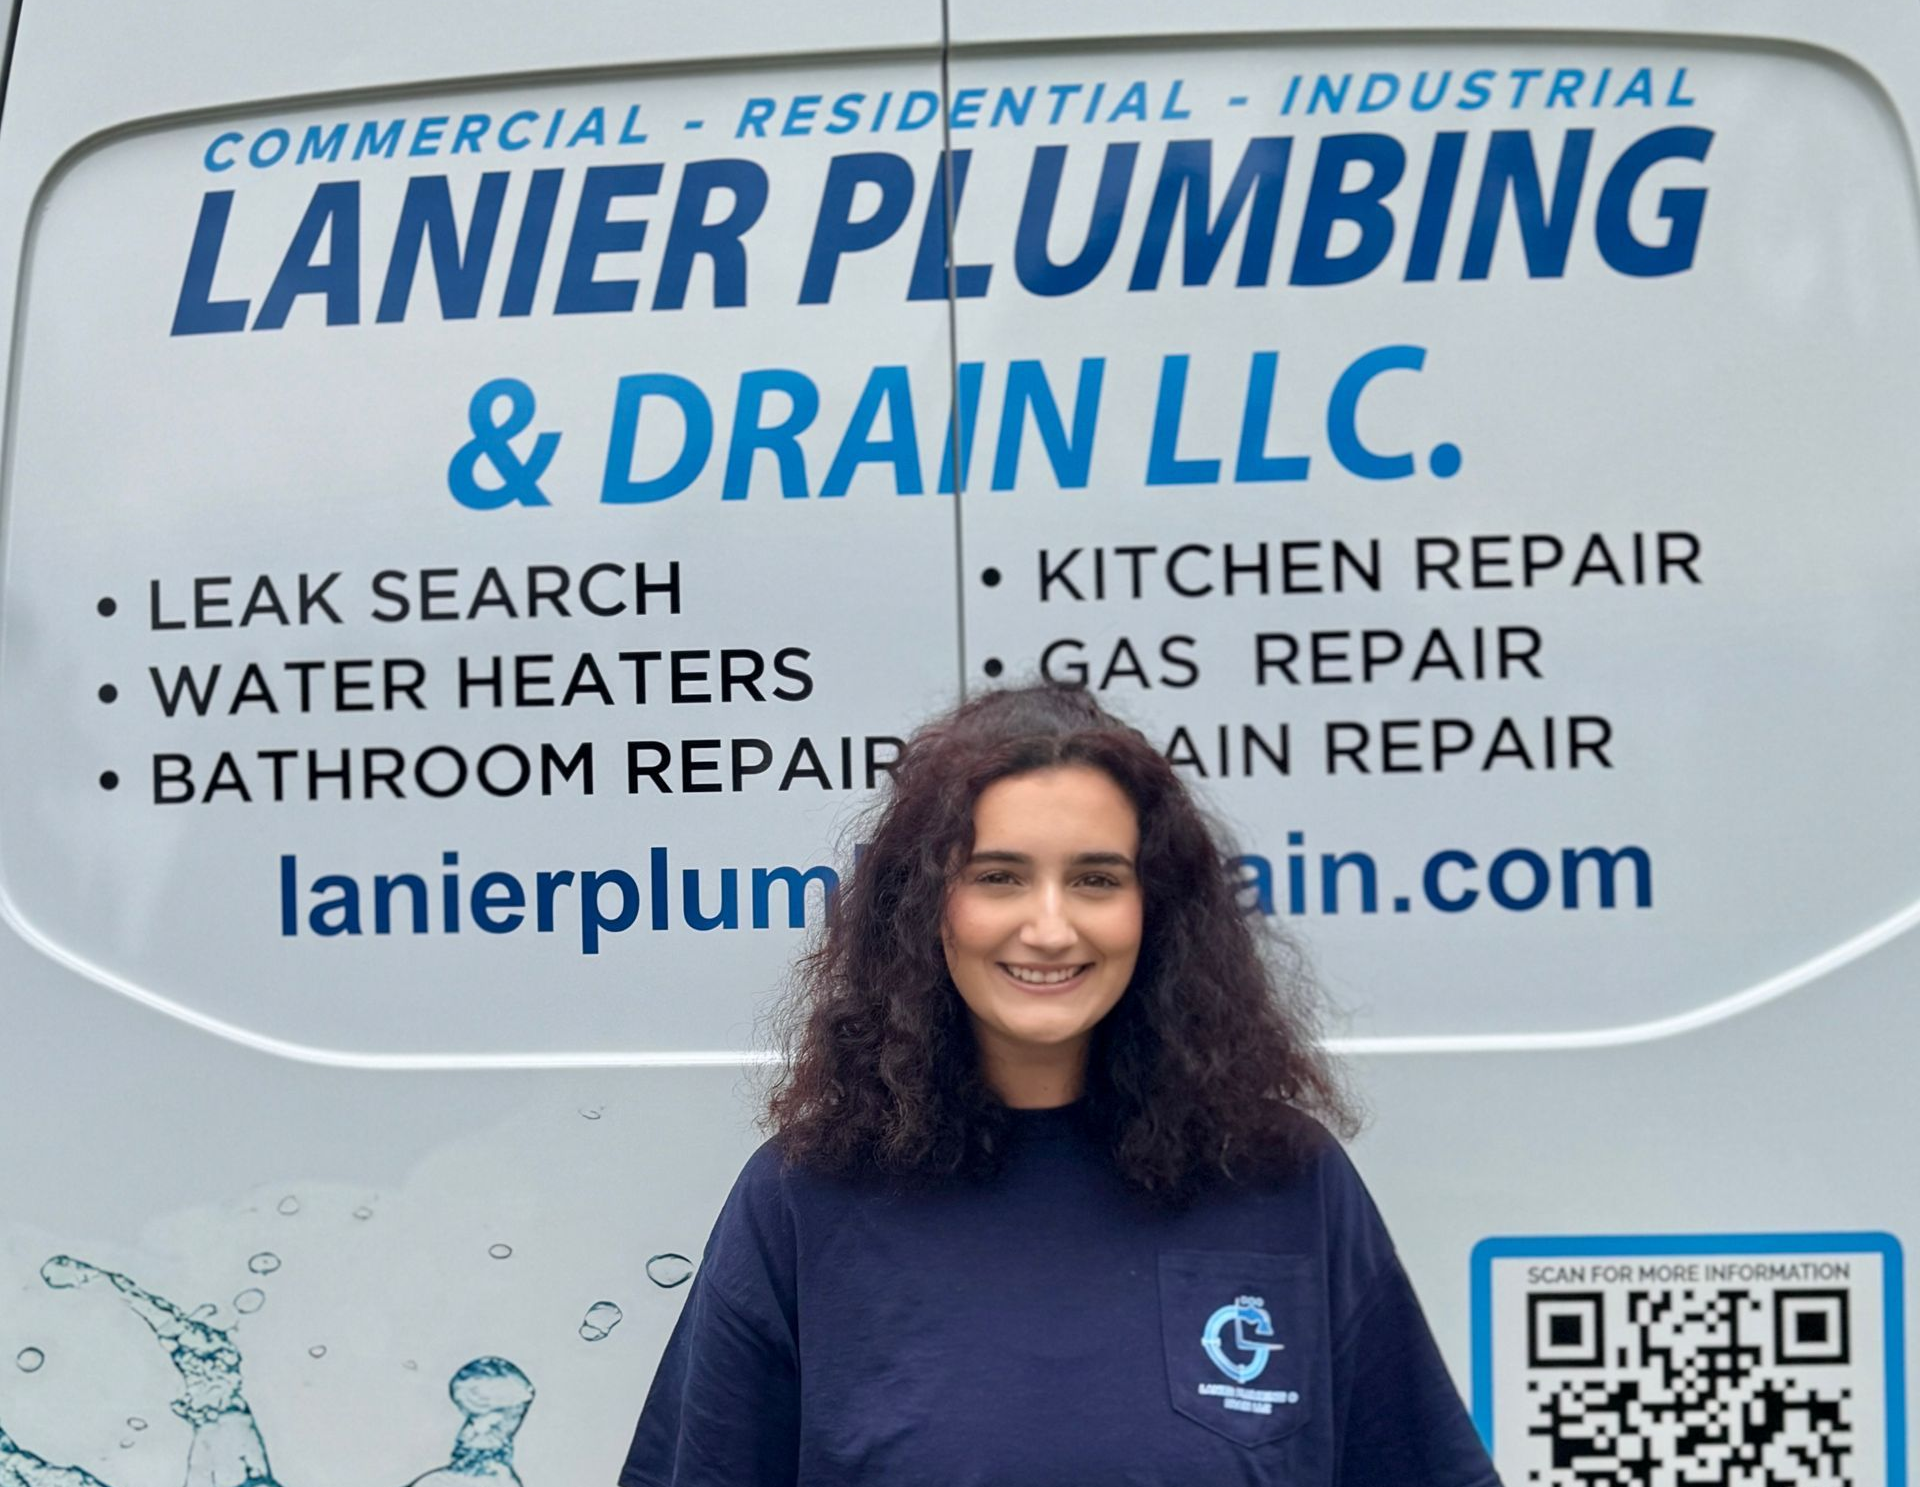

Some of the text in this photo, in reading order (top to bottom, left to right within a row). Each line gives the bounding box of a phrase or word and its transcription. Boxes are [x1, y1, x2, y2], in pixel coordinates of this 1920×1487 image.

[203, 104, 650, 174] COMMERCIAL
[735, 79, 1192, 139] RESIDENTIAL
[1281, 67, 1696, 116] INDUSTRIAL
[170, 126, 1716, 337] LANIER PLUMBING
[447, 344, 1463, 511] & DRAIN LLC.
[150, 561, 682, 631] LEAK SEARCH
[1039, 532, 1702, 602] KITCHEN REPAIR
[149, 647, 814, 717] WATER HEATERS
[1040, 626, 1543, 690] GAS REPAIR
[153, 736, 907, 805] BATHROOM REPAIR
[1163, 715, 1613, 778] AIN REPAIR
[1528, 1262, 1850, 1284] SCAN FOR MORE INFORMATION
